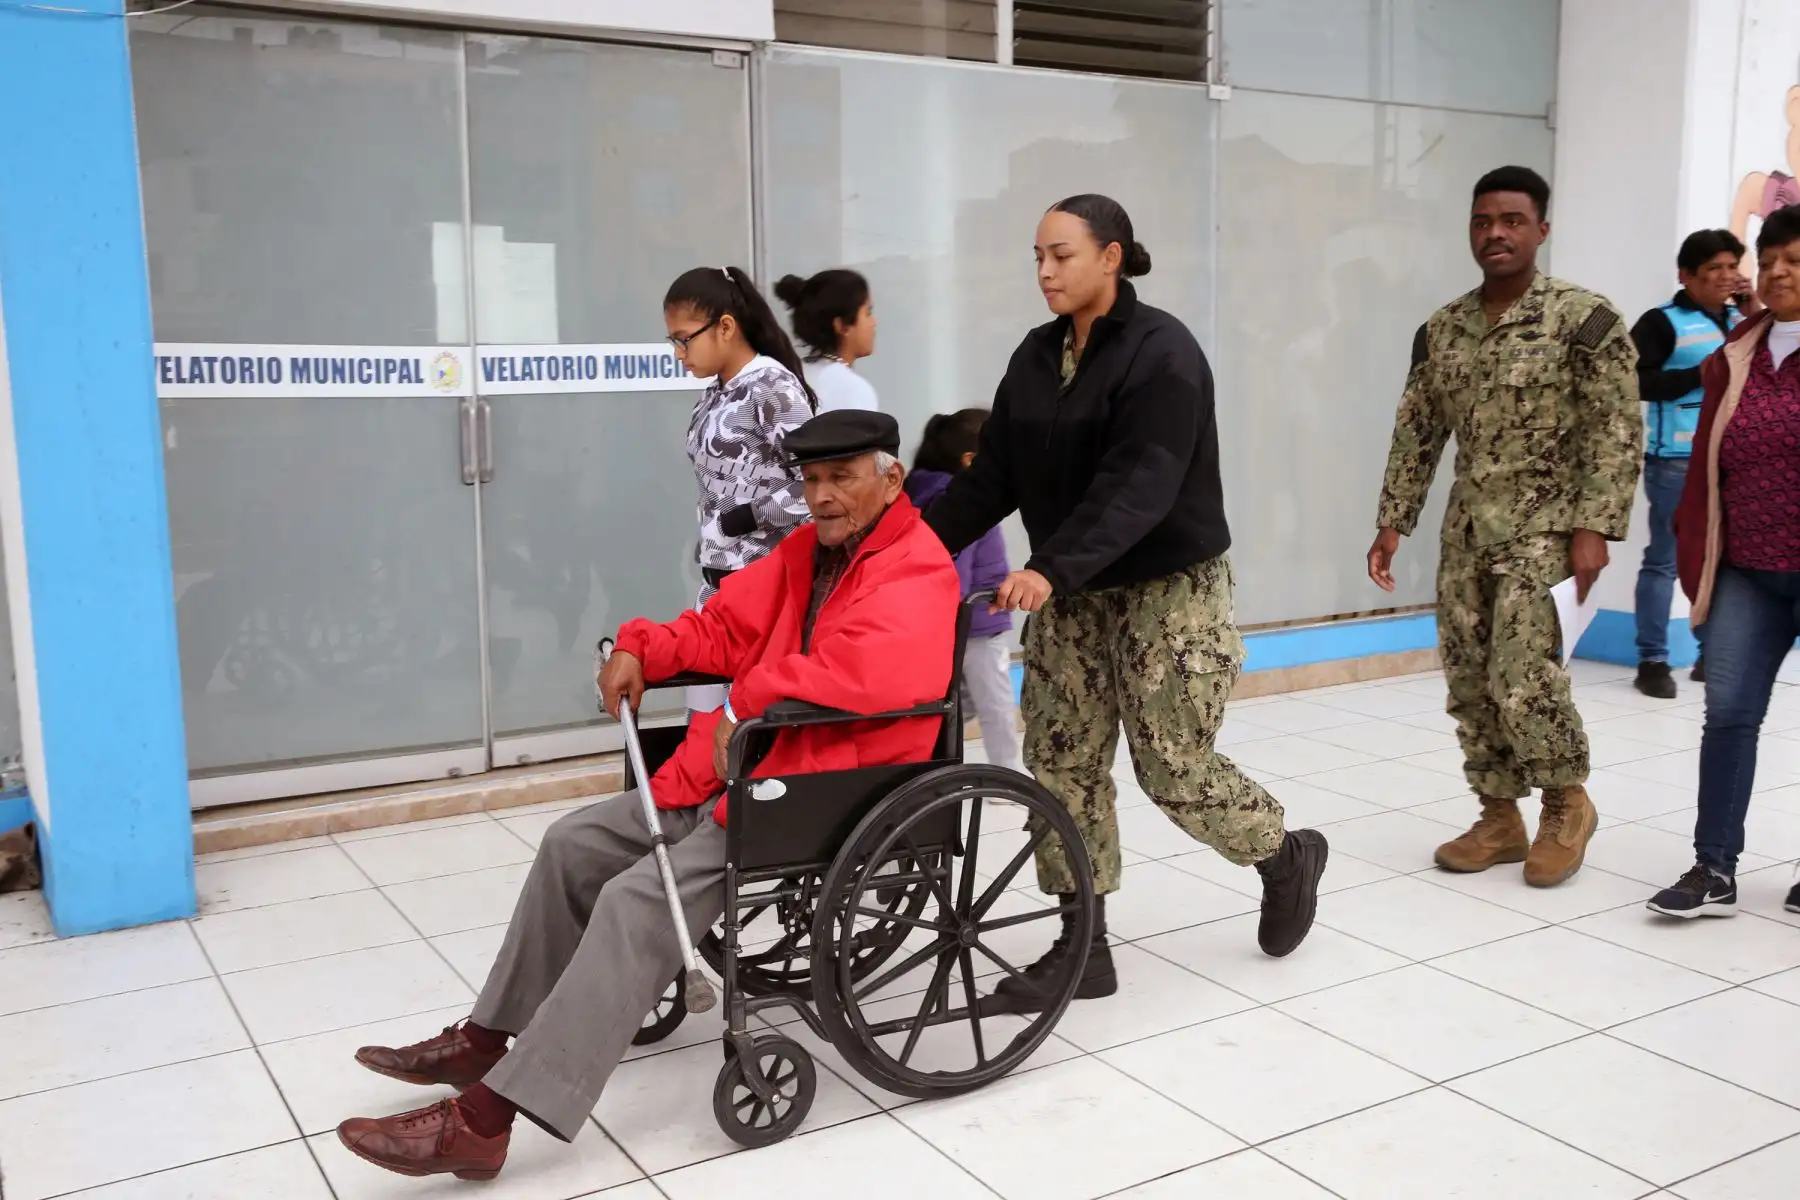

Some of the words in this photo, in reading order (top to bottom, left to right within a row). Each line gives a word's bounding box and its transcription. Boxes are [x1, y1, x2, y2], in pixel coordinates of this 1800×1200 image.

[154, 356, 283, 384] ELATORIO
[289, 357, 424, 384] MUNICIPAL
[481, 355, 598, 382] VELATORIO
